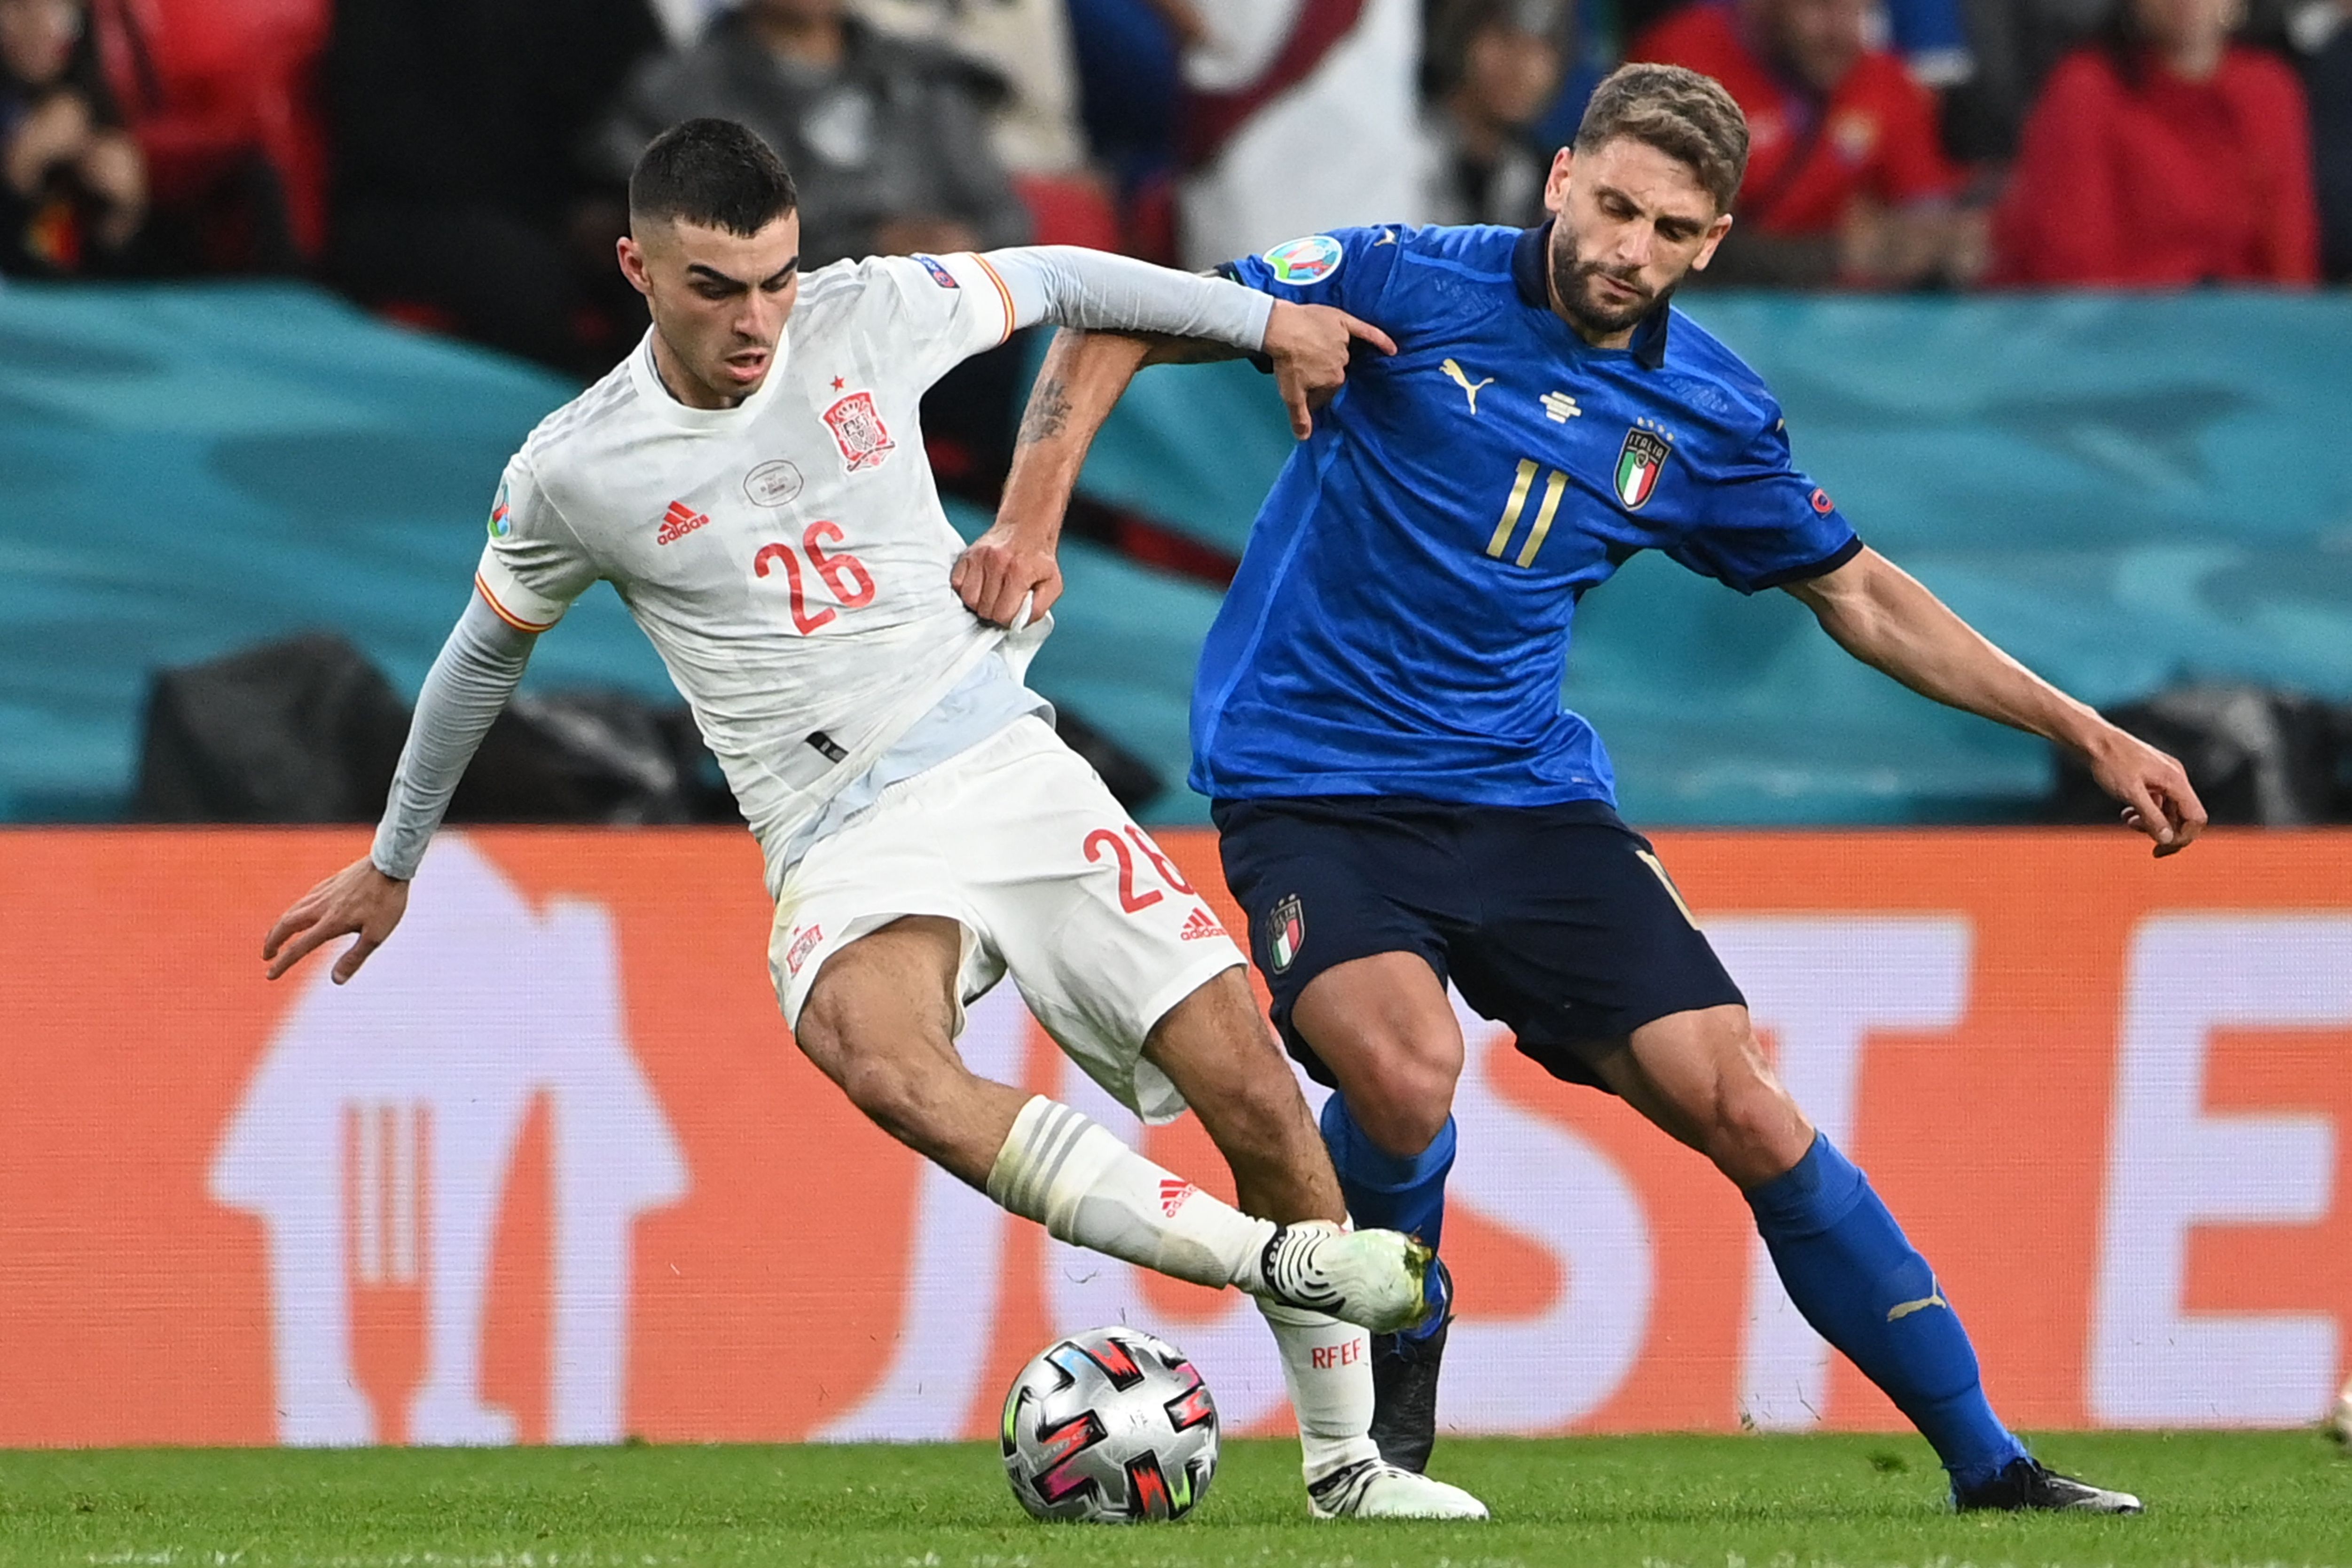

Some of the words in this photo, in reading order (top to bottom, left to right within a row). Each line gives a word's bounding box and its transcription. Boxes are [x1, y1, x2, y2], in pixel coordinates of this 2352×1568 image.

[1629, 434, 1664, 459] ITALIA
[1486, 458, 1570, 569] 11
[657, 514, 710, 546] adidas
[754, 520, 875, 635] 26
[1311, 1337, 1361, 1369] RFEF
